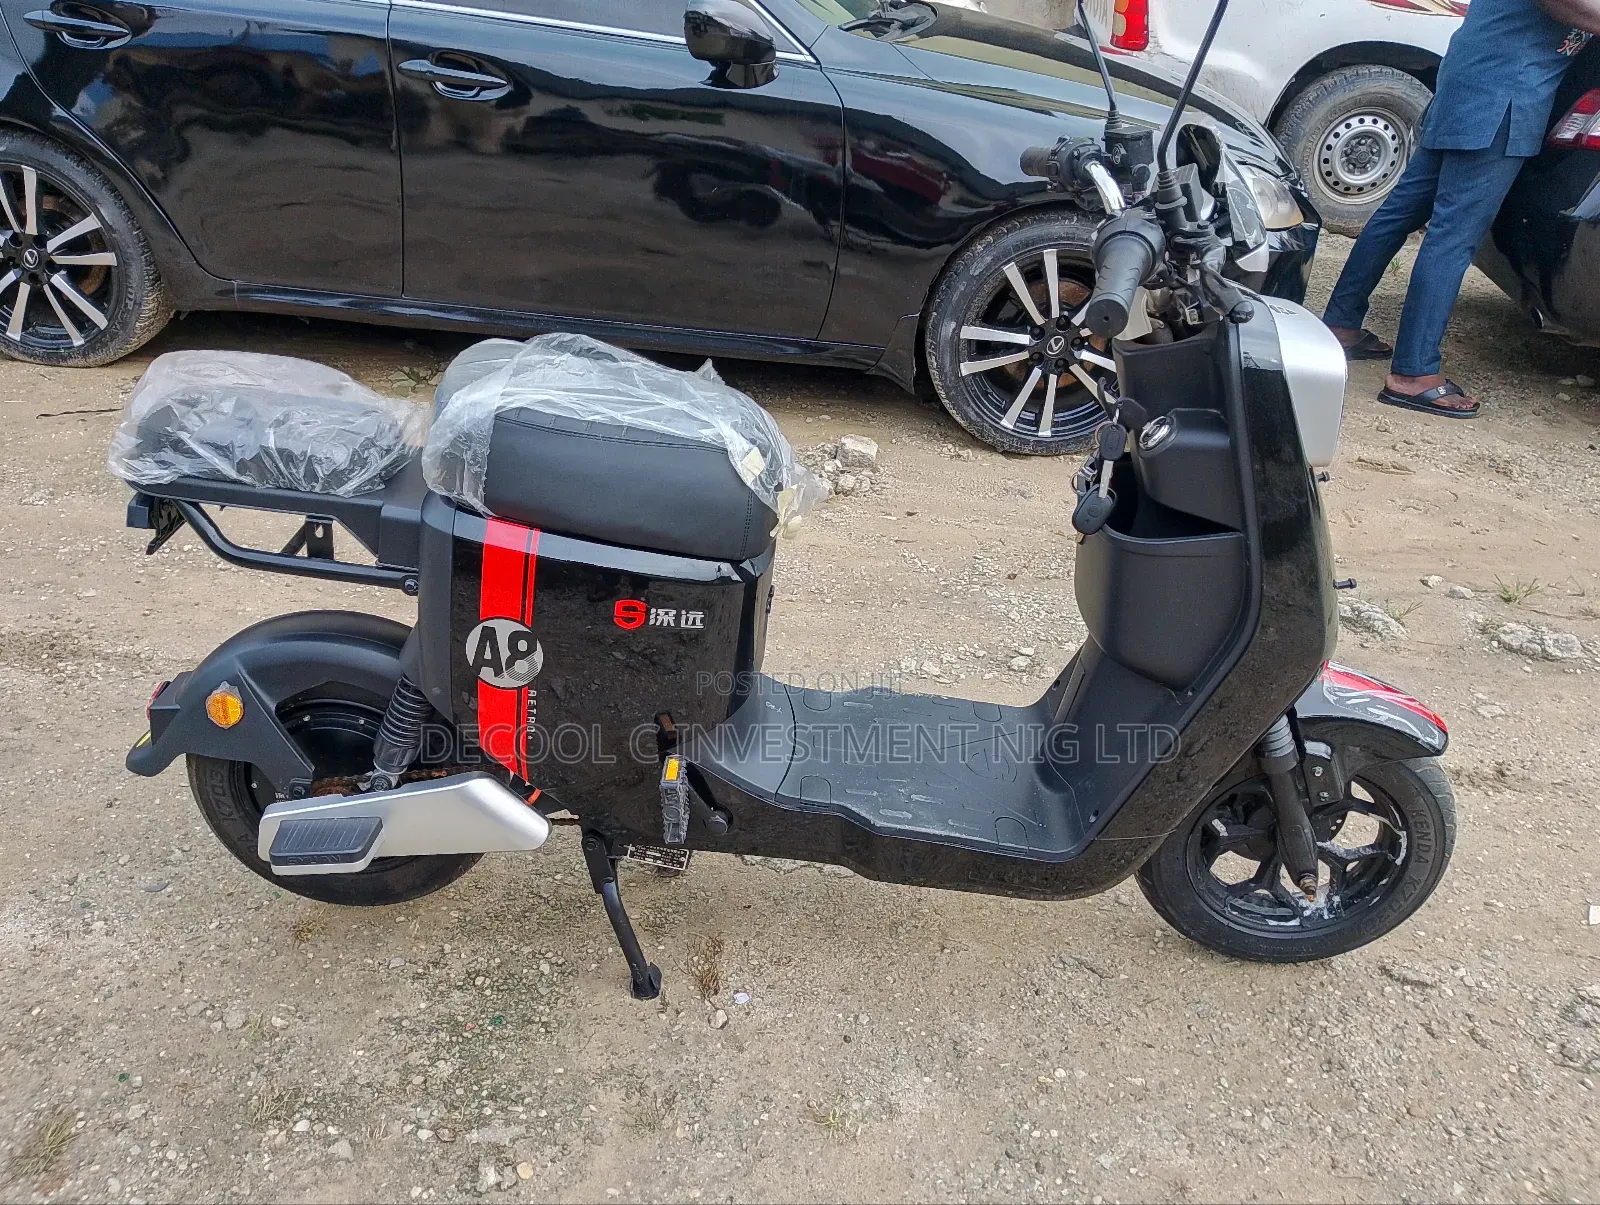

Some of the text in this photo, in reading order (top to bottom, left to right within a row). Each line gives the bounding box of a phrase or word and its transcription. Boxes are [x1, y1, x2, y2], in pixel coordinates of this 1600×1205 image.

[648, 608, 705, 629] 深远
[471, 625, 539, 684] A8
[527, 689, 537, 733] RETRO
[1410, 808, 1432, 864] KENDA
